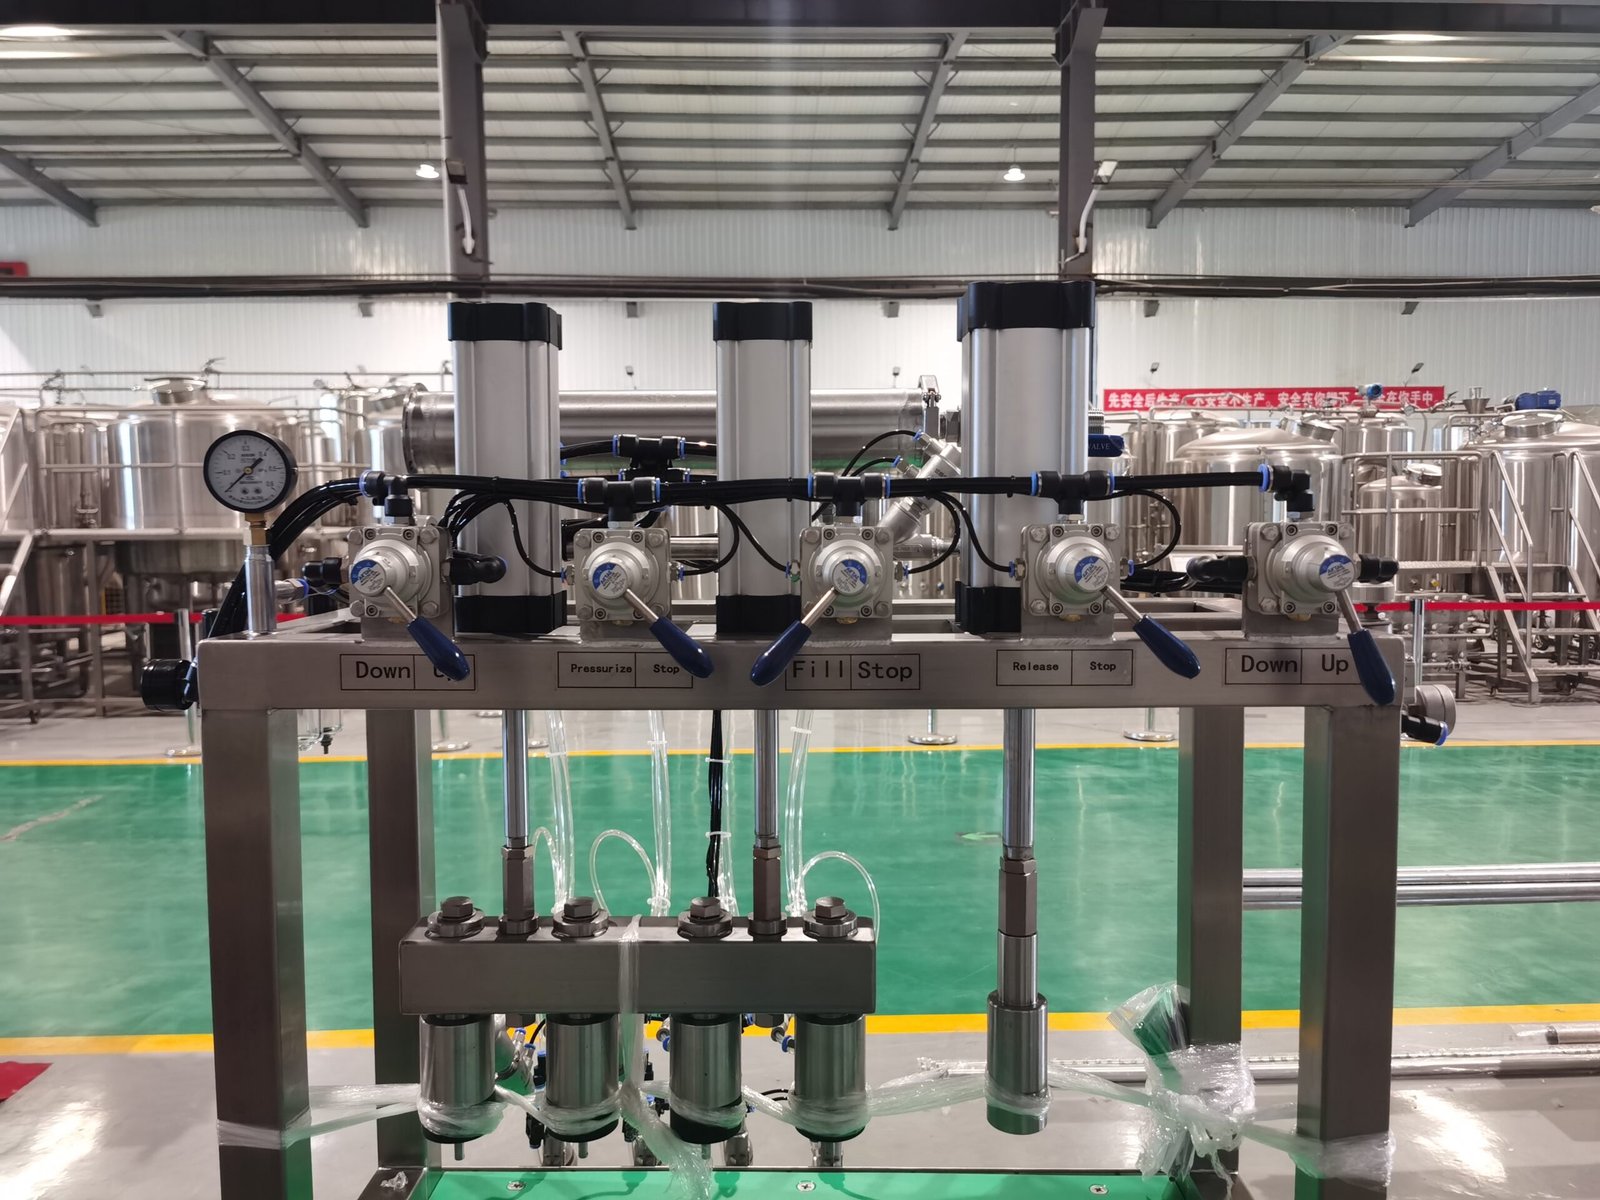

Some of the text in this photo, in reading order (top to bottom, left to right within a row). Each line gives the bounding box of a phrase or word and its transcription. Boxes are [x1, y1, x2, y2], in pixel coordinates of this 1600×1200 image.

[355, 661, 411, 679] Down
[570, 663, 633, 673] Pressurize
[653, 663, 680, 675] Stop
[793, 660, 843, 678] Fill
[858, 661, 913, 682] Stop
[1012, 661, 1059, 671] Release
[1089, 660, 1117, 672] Stop
[1241, 655, 1298, 673] Down
[1321, 653, 1349, 675] Up
